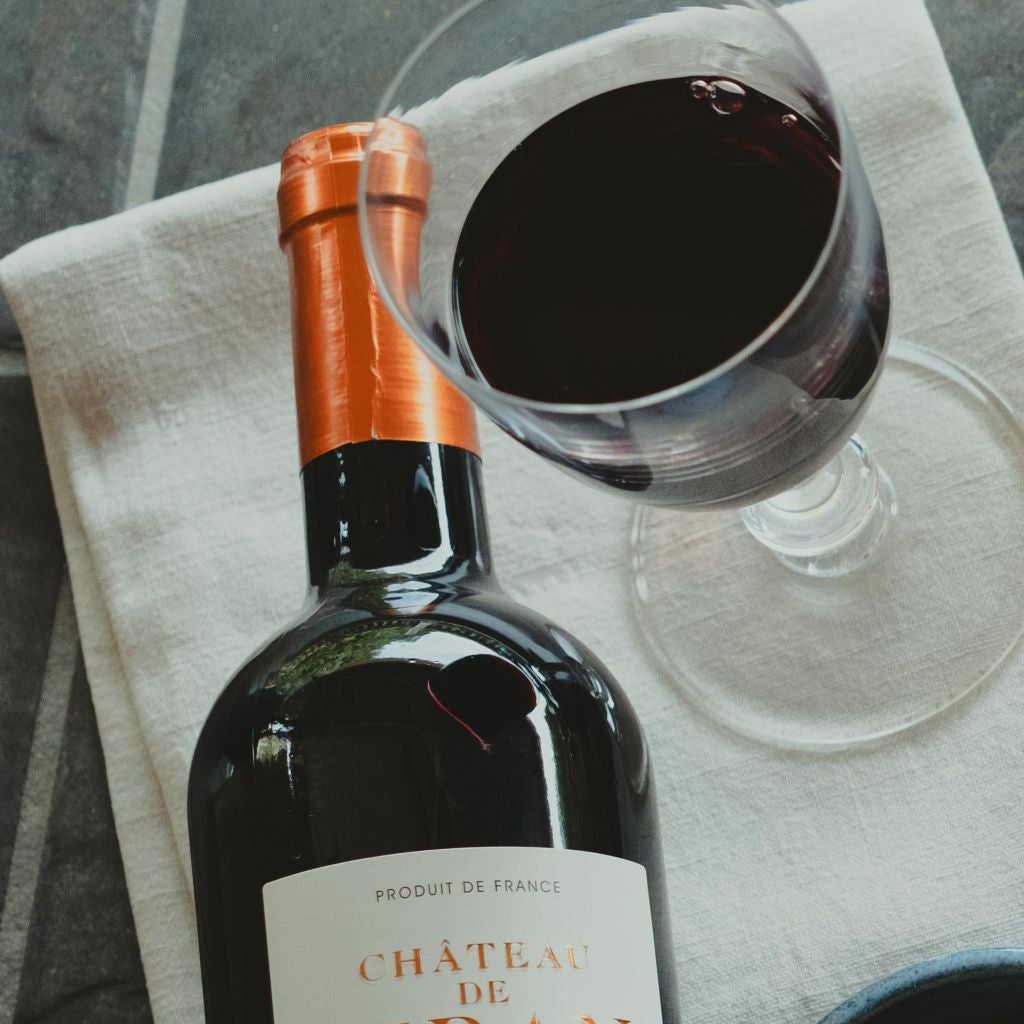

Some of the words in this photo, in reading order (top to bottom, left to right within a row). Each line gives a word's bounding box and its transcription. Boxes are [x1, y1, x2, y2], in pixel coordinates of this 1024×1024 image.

[376, 882, 452, 902] PRODUIT
[462, 881, 484, 893] DE
[494, 880, 560, 893] FRANCE
[358, 939, 590, 982] CHÂTEAU
[458, 980, 510, 1006] DE
